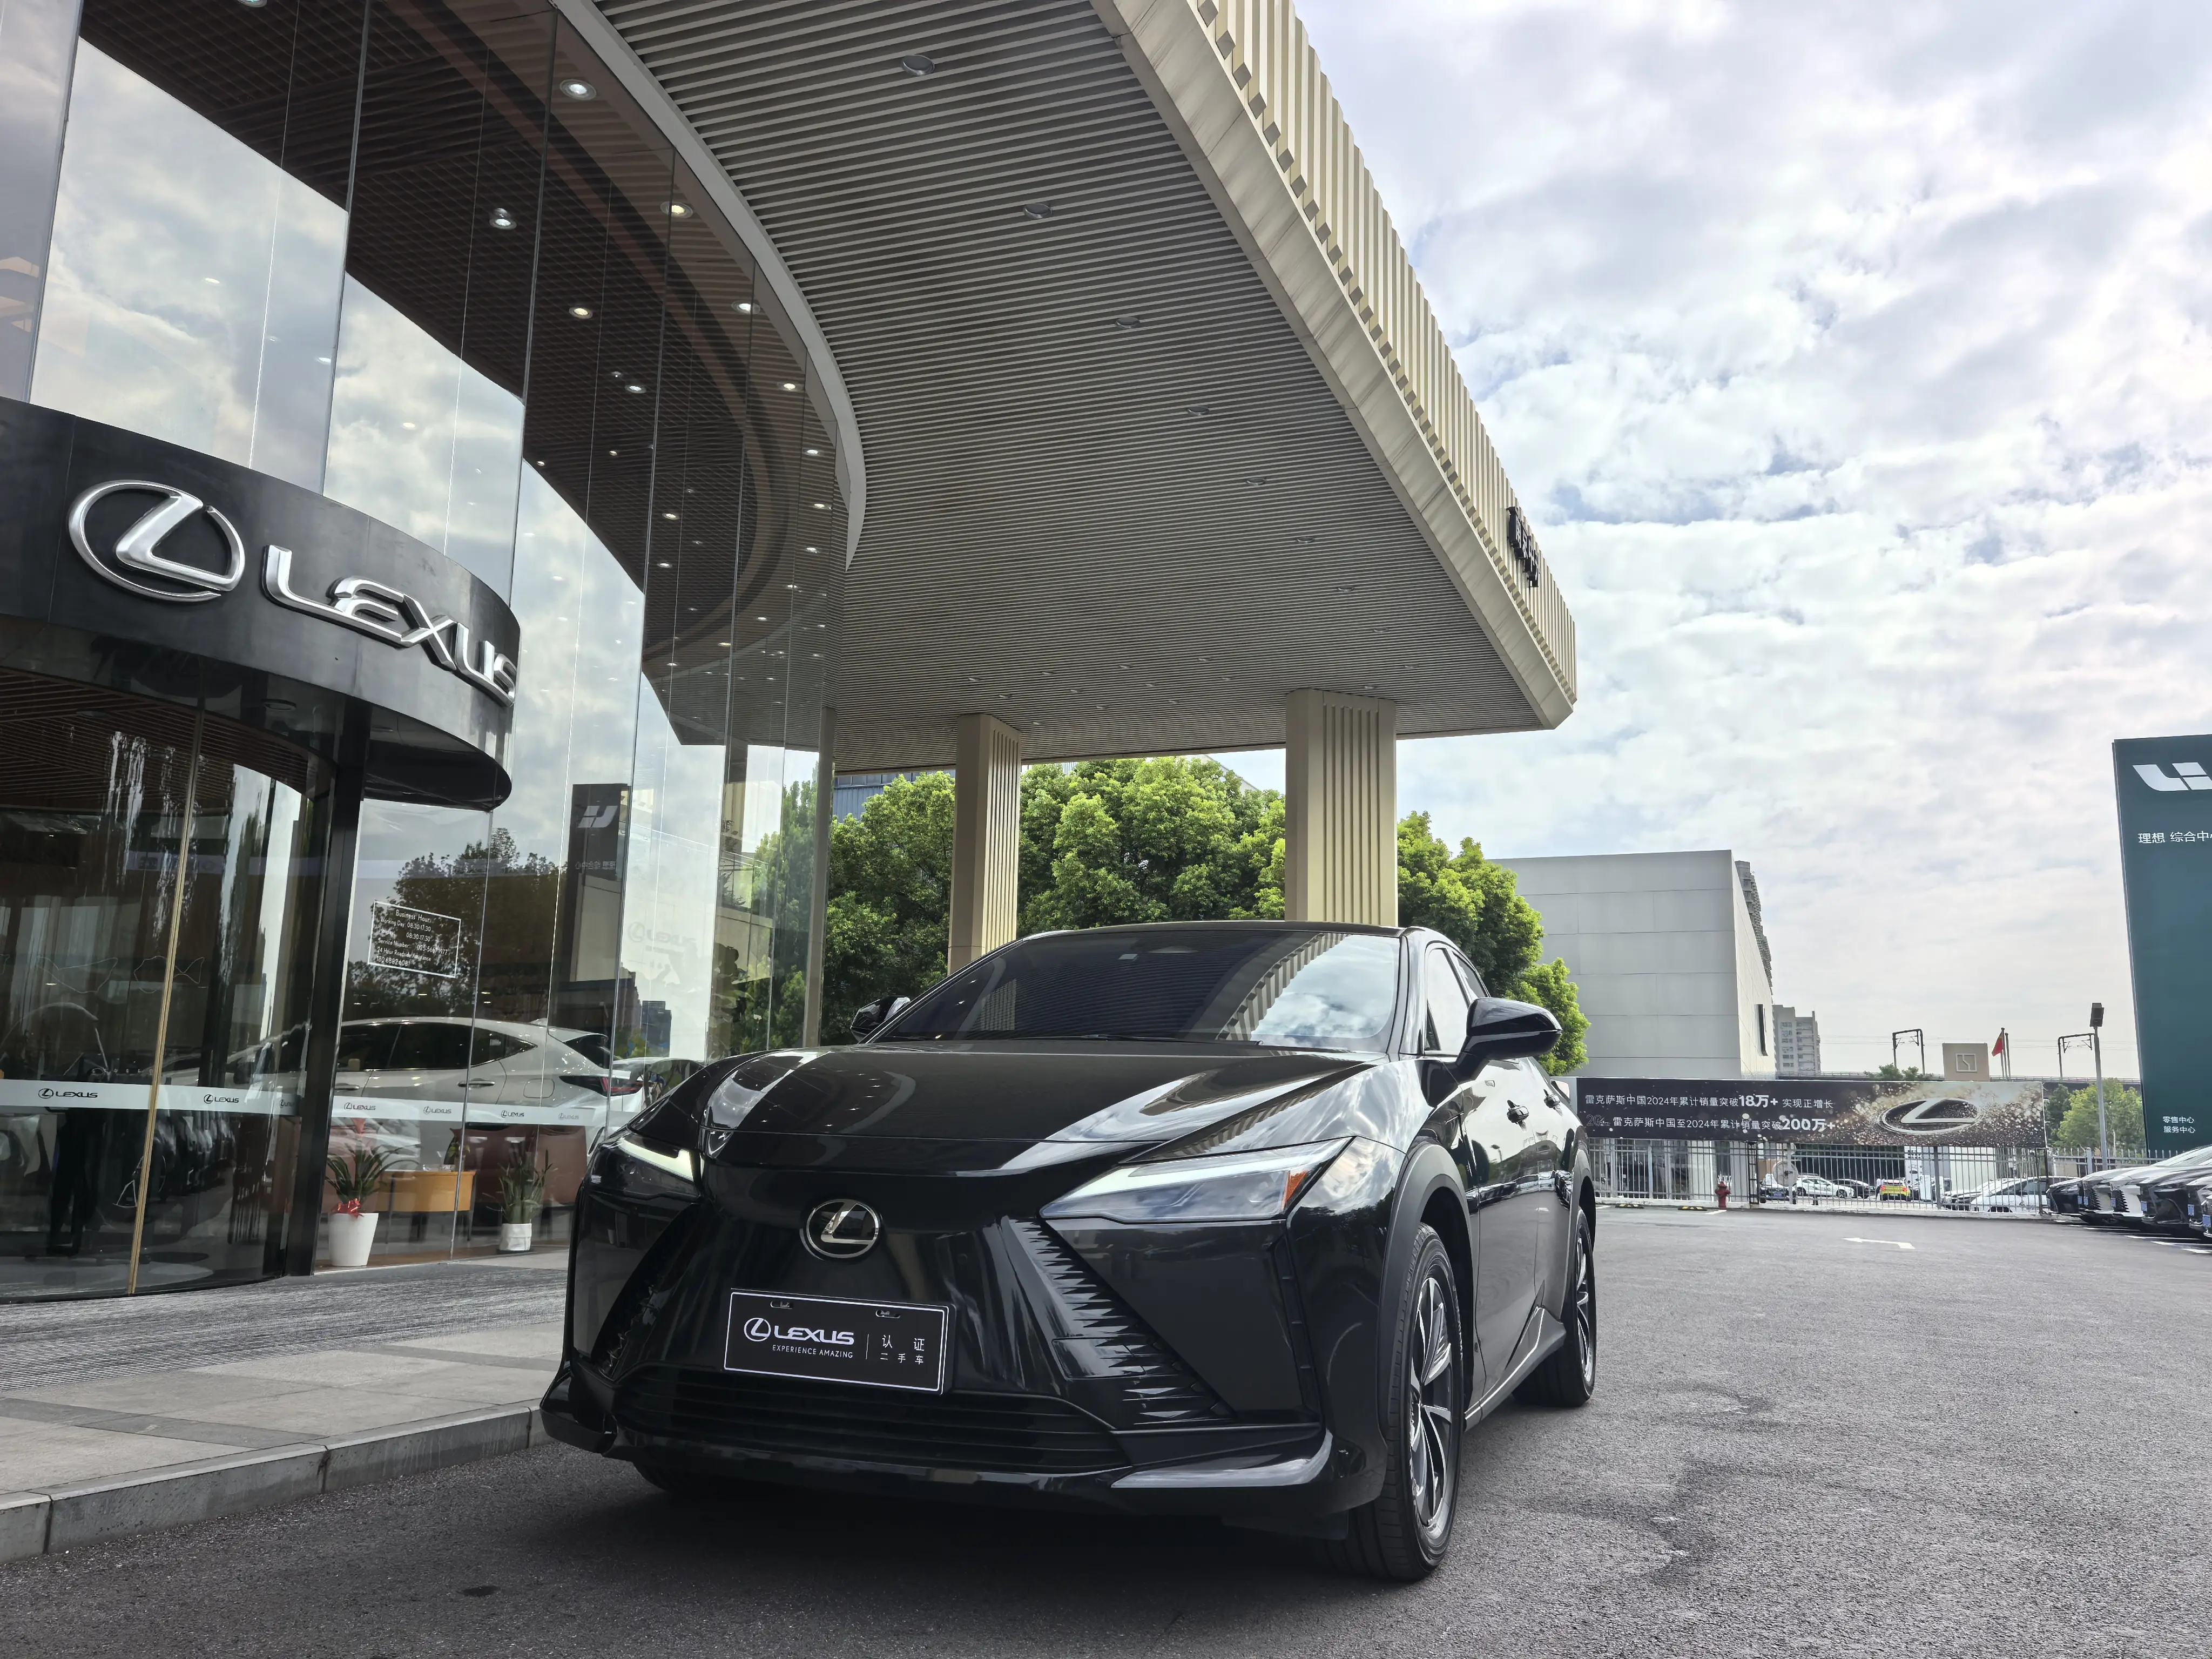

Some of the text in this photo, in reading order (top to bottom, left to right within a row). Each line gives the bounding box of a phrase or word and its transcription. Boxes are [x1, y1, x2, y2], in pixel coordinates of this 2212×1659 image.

[262, 544, 516, 707] LEXUS
[2137, 831, 2212, 844] 理想 综合中
[396, 909, 416, 920] Business
[377, 938, 393, 946] Service
[1782, 1098, 1834, 1109] 实现正增长
[2163, 1125, 2196, 1134] 服务中心
[774, 1325, 854, 1345] LEXUS
[772, 1345, 853, 1358] EXPERIENCE AMAZING
